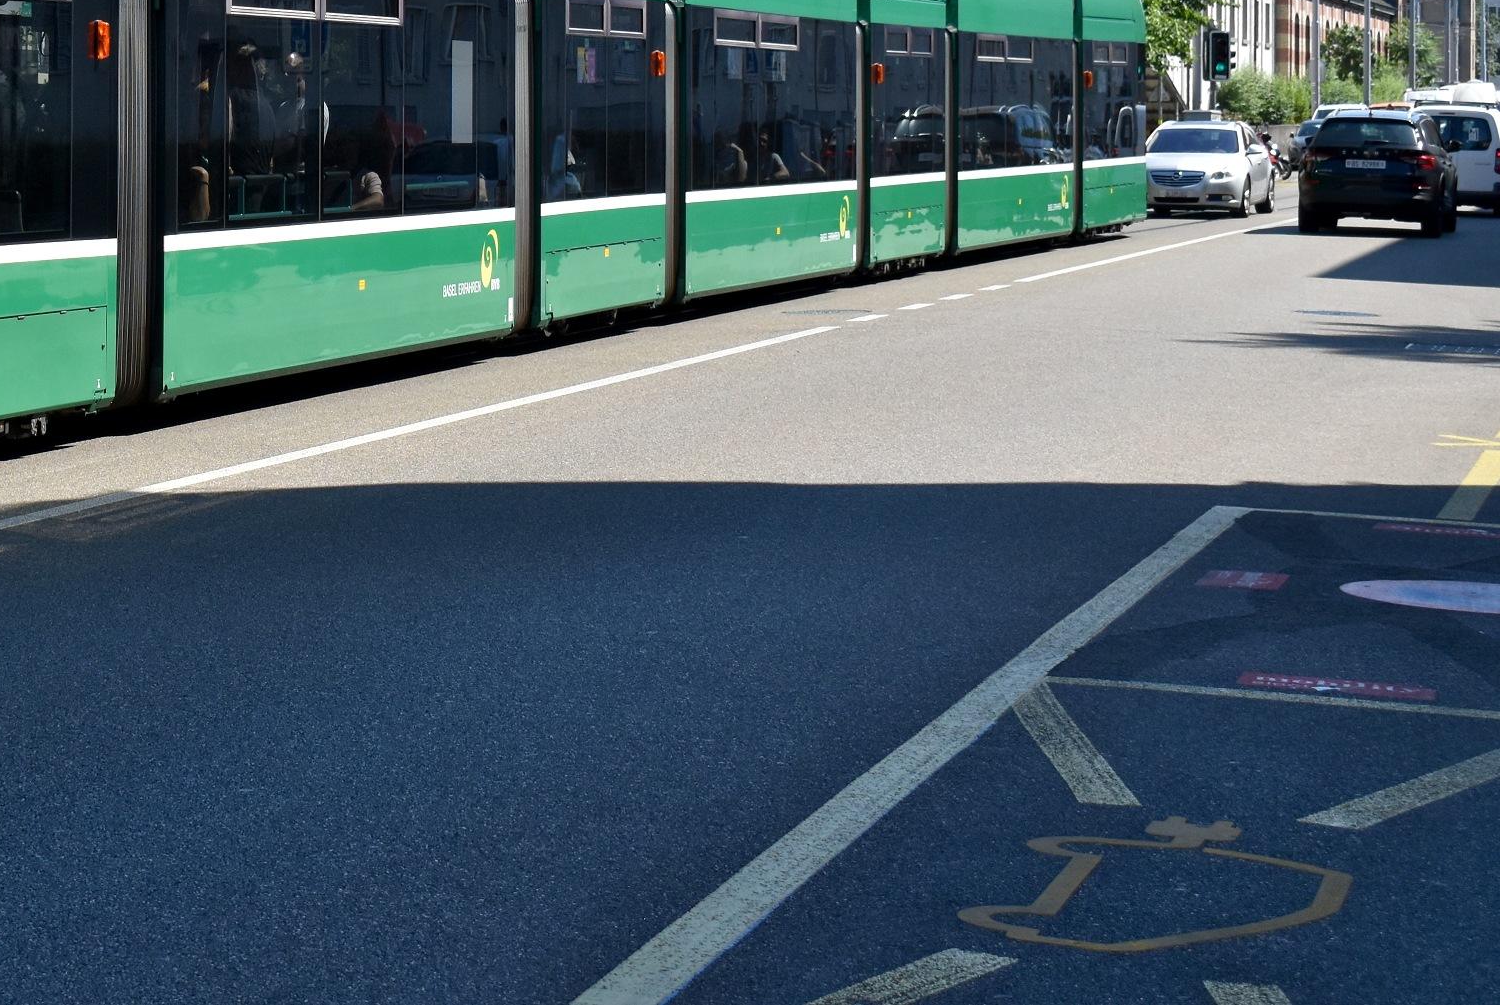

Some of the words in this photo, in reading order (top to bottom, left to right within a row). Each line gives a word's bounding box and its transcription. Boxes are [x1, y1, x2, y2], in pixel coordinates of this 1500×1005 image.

[442, 284, 457, 298] BASEL
[458, 281, 482, 296] ERFAHREN
[491, 278, 500, 291] BVB
